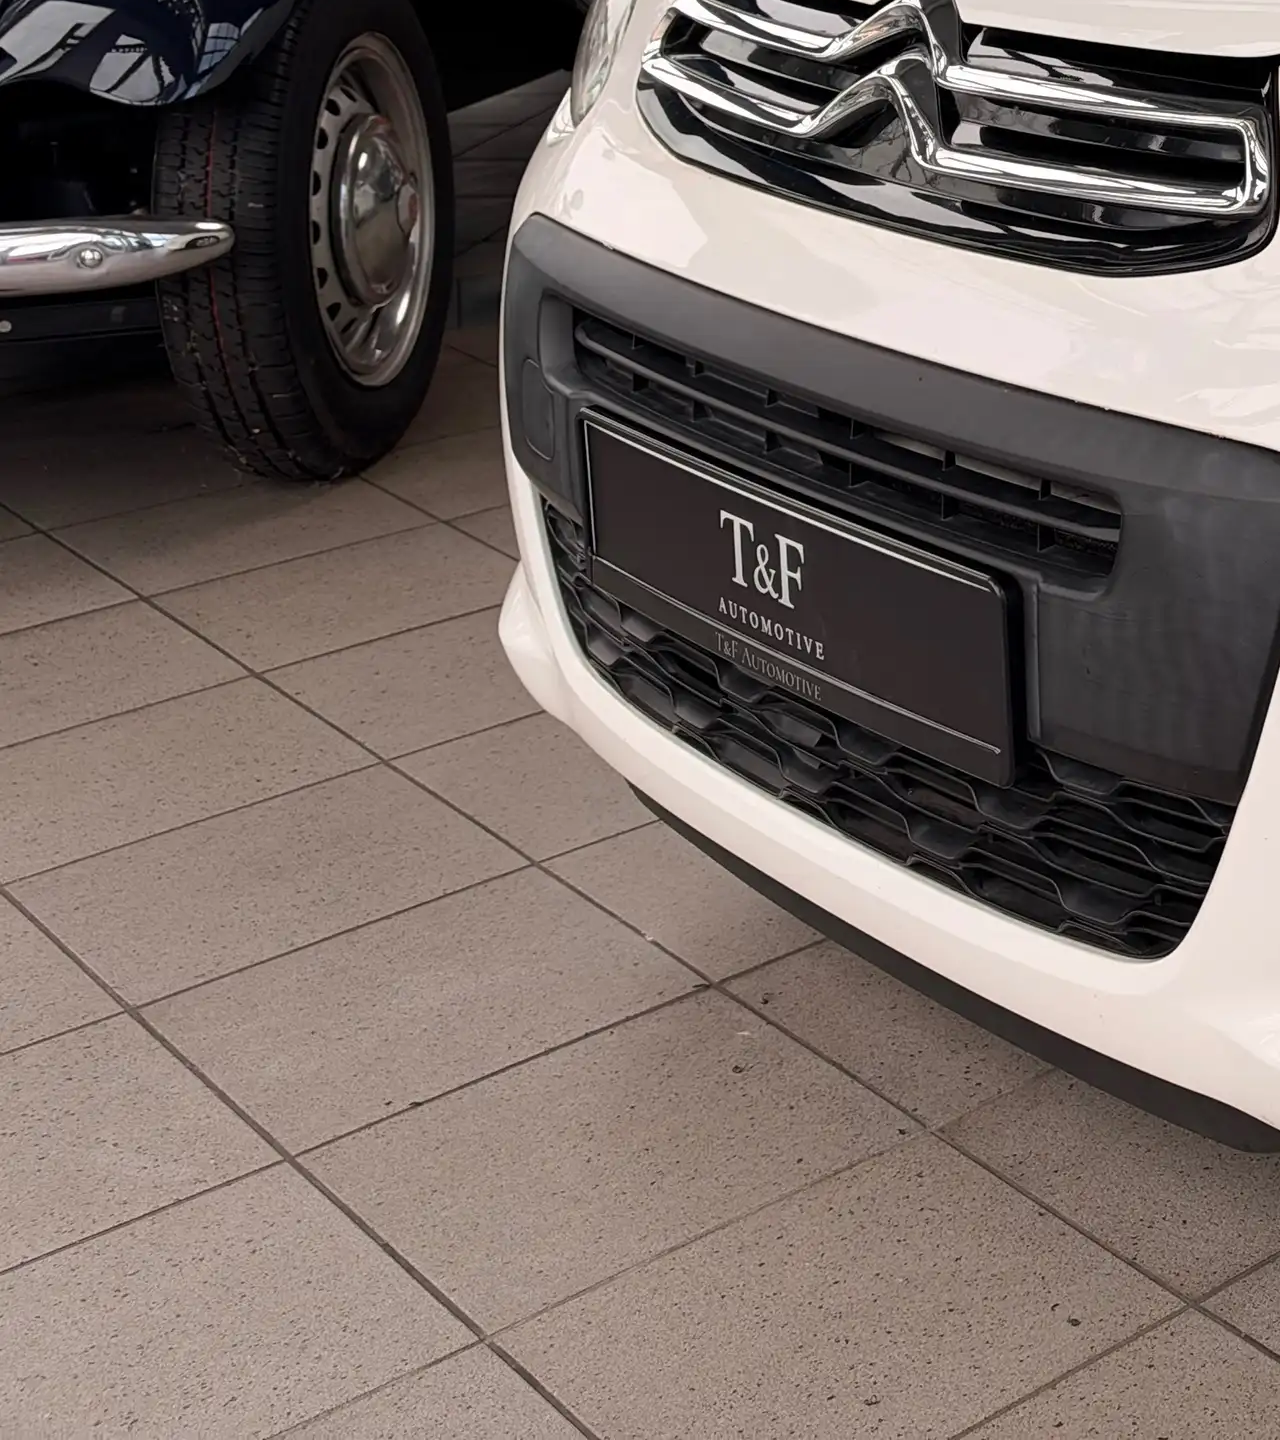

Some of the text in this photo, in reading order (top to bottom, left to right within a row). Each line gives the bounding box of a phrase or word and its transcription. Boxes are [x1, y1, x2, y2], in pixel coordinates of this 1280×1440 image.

[720, 510, 805, 609] T&F
[718, 596, 825, 661] AUTOMOTIVE
[716, 632, 822, 701] T&F AUTOMOTIVE
